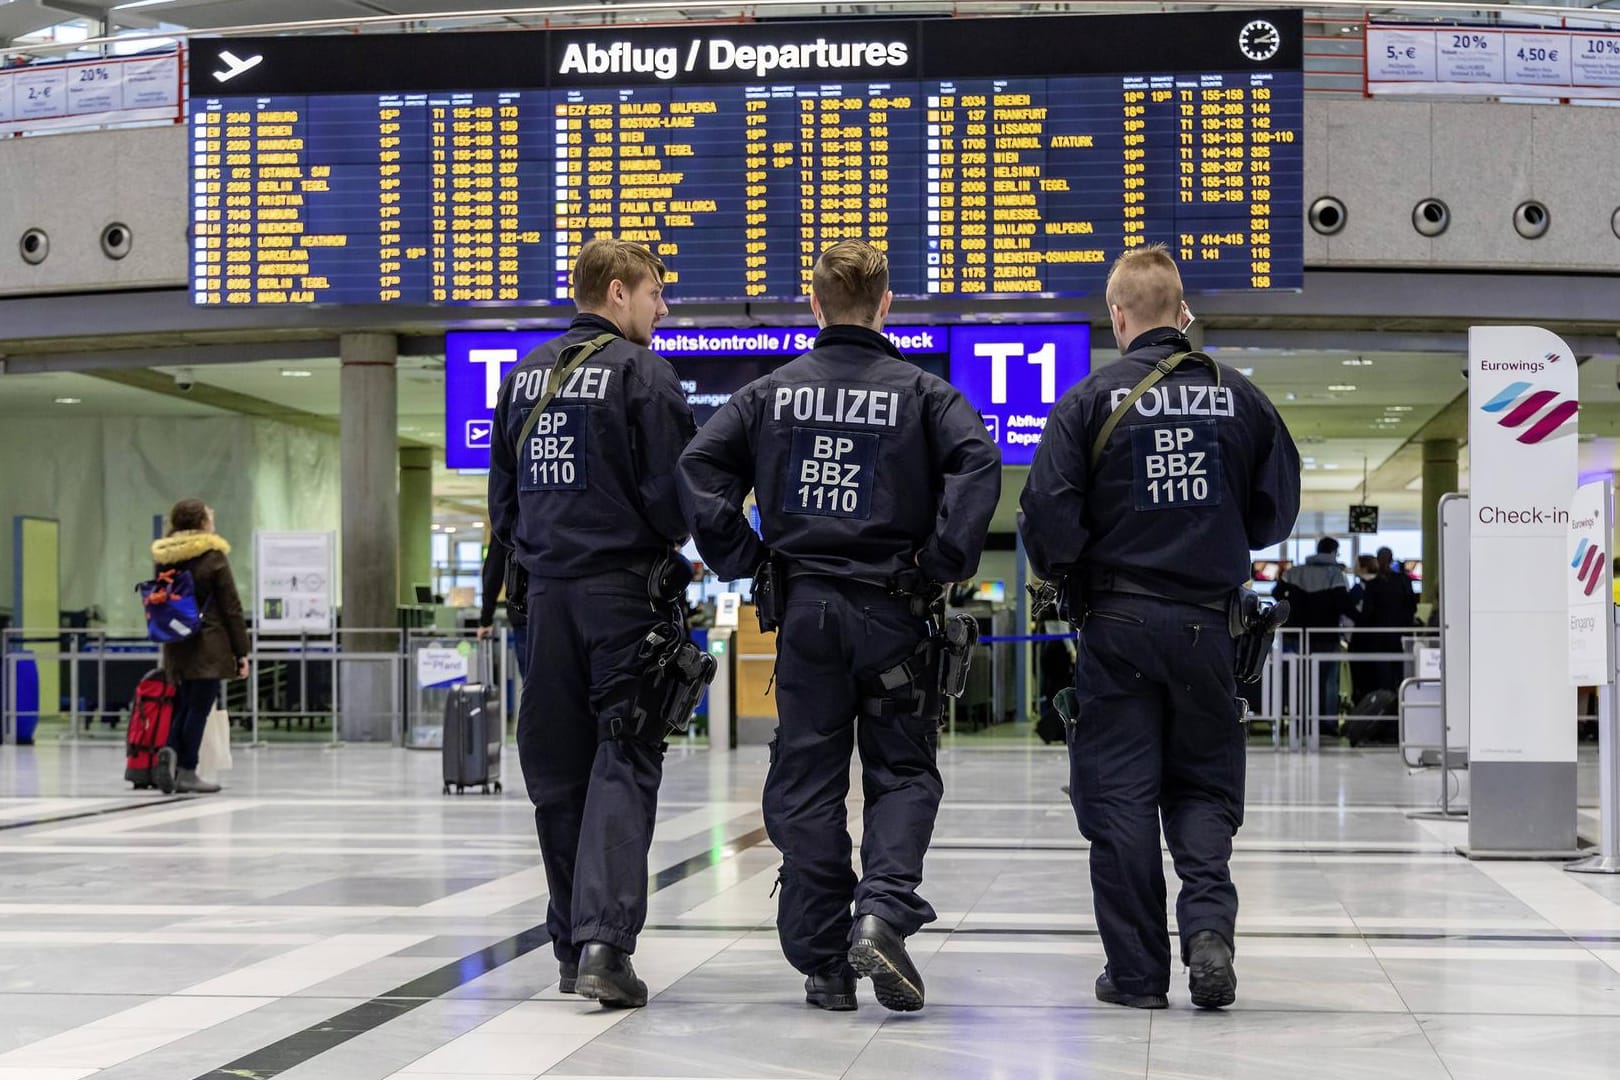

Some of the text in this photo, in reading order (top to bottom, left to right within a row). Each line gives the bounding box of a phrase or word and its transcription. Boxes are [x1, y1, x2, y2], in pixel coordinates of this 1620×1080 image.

[559, 39, 909, 79] Abflug / Departures
[1517, 48, 1546, 62] 4,50
[1181, 91, 1192, 100] T1
[994, 108, 1046, 120] FRANKFURT
[1181, 105, 1193, 115] T2
[1252, 104, 1270, 113] 144
[1182, 119, 1192, 129] T1
[1252, 117, 1270, 128] 142
[1051, 136, 1092, 147] ATATURK
[1181, 134, 1192, 144] T1
[1181, 148, 1192, 158] T1
[941, 168, 953, 178] AY
[994, 166, 1039, 177] HELSINKI
[1251, 161, 1270, 172] 314
[1040, 180, 1068, 191] TEGEL
[1181, 177, 1192, 187] T1
[1181, 191, 1192, 201] T1
[1181, 235, 1194, 245] T4
[1181, 249, 1192, 259] T1
[1202, 249, 1218, 259] 141
[648, 332, 933, 351] rheitskontrolle / Se heck
[974, 343, 1056, 404] T1
[1481, 360, 1545, 373] Eurowings
[774, 387, 899, 427] POLIZEI
[537, 412, 567, 435] BP
[1007, 431, 1041, 446] Depa
[1154, 428, 1194, 452] BP
[531, 436, 574, 460] BBZ
[813, 436, 854, 460] BP
[530, 461, 575, 484] 1110
[801, 459, 860, 487] BBZ
[1146, 452, 1207, 478] BBZ
[798, 485, 857, 512] 1110
[1147, 477, 1208, 503] 1110
[1478, 506, 1569, 524] Check-in
